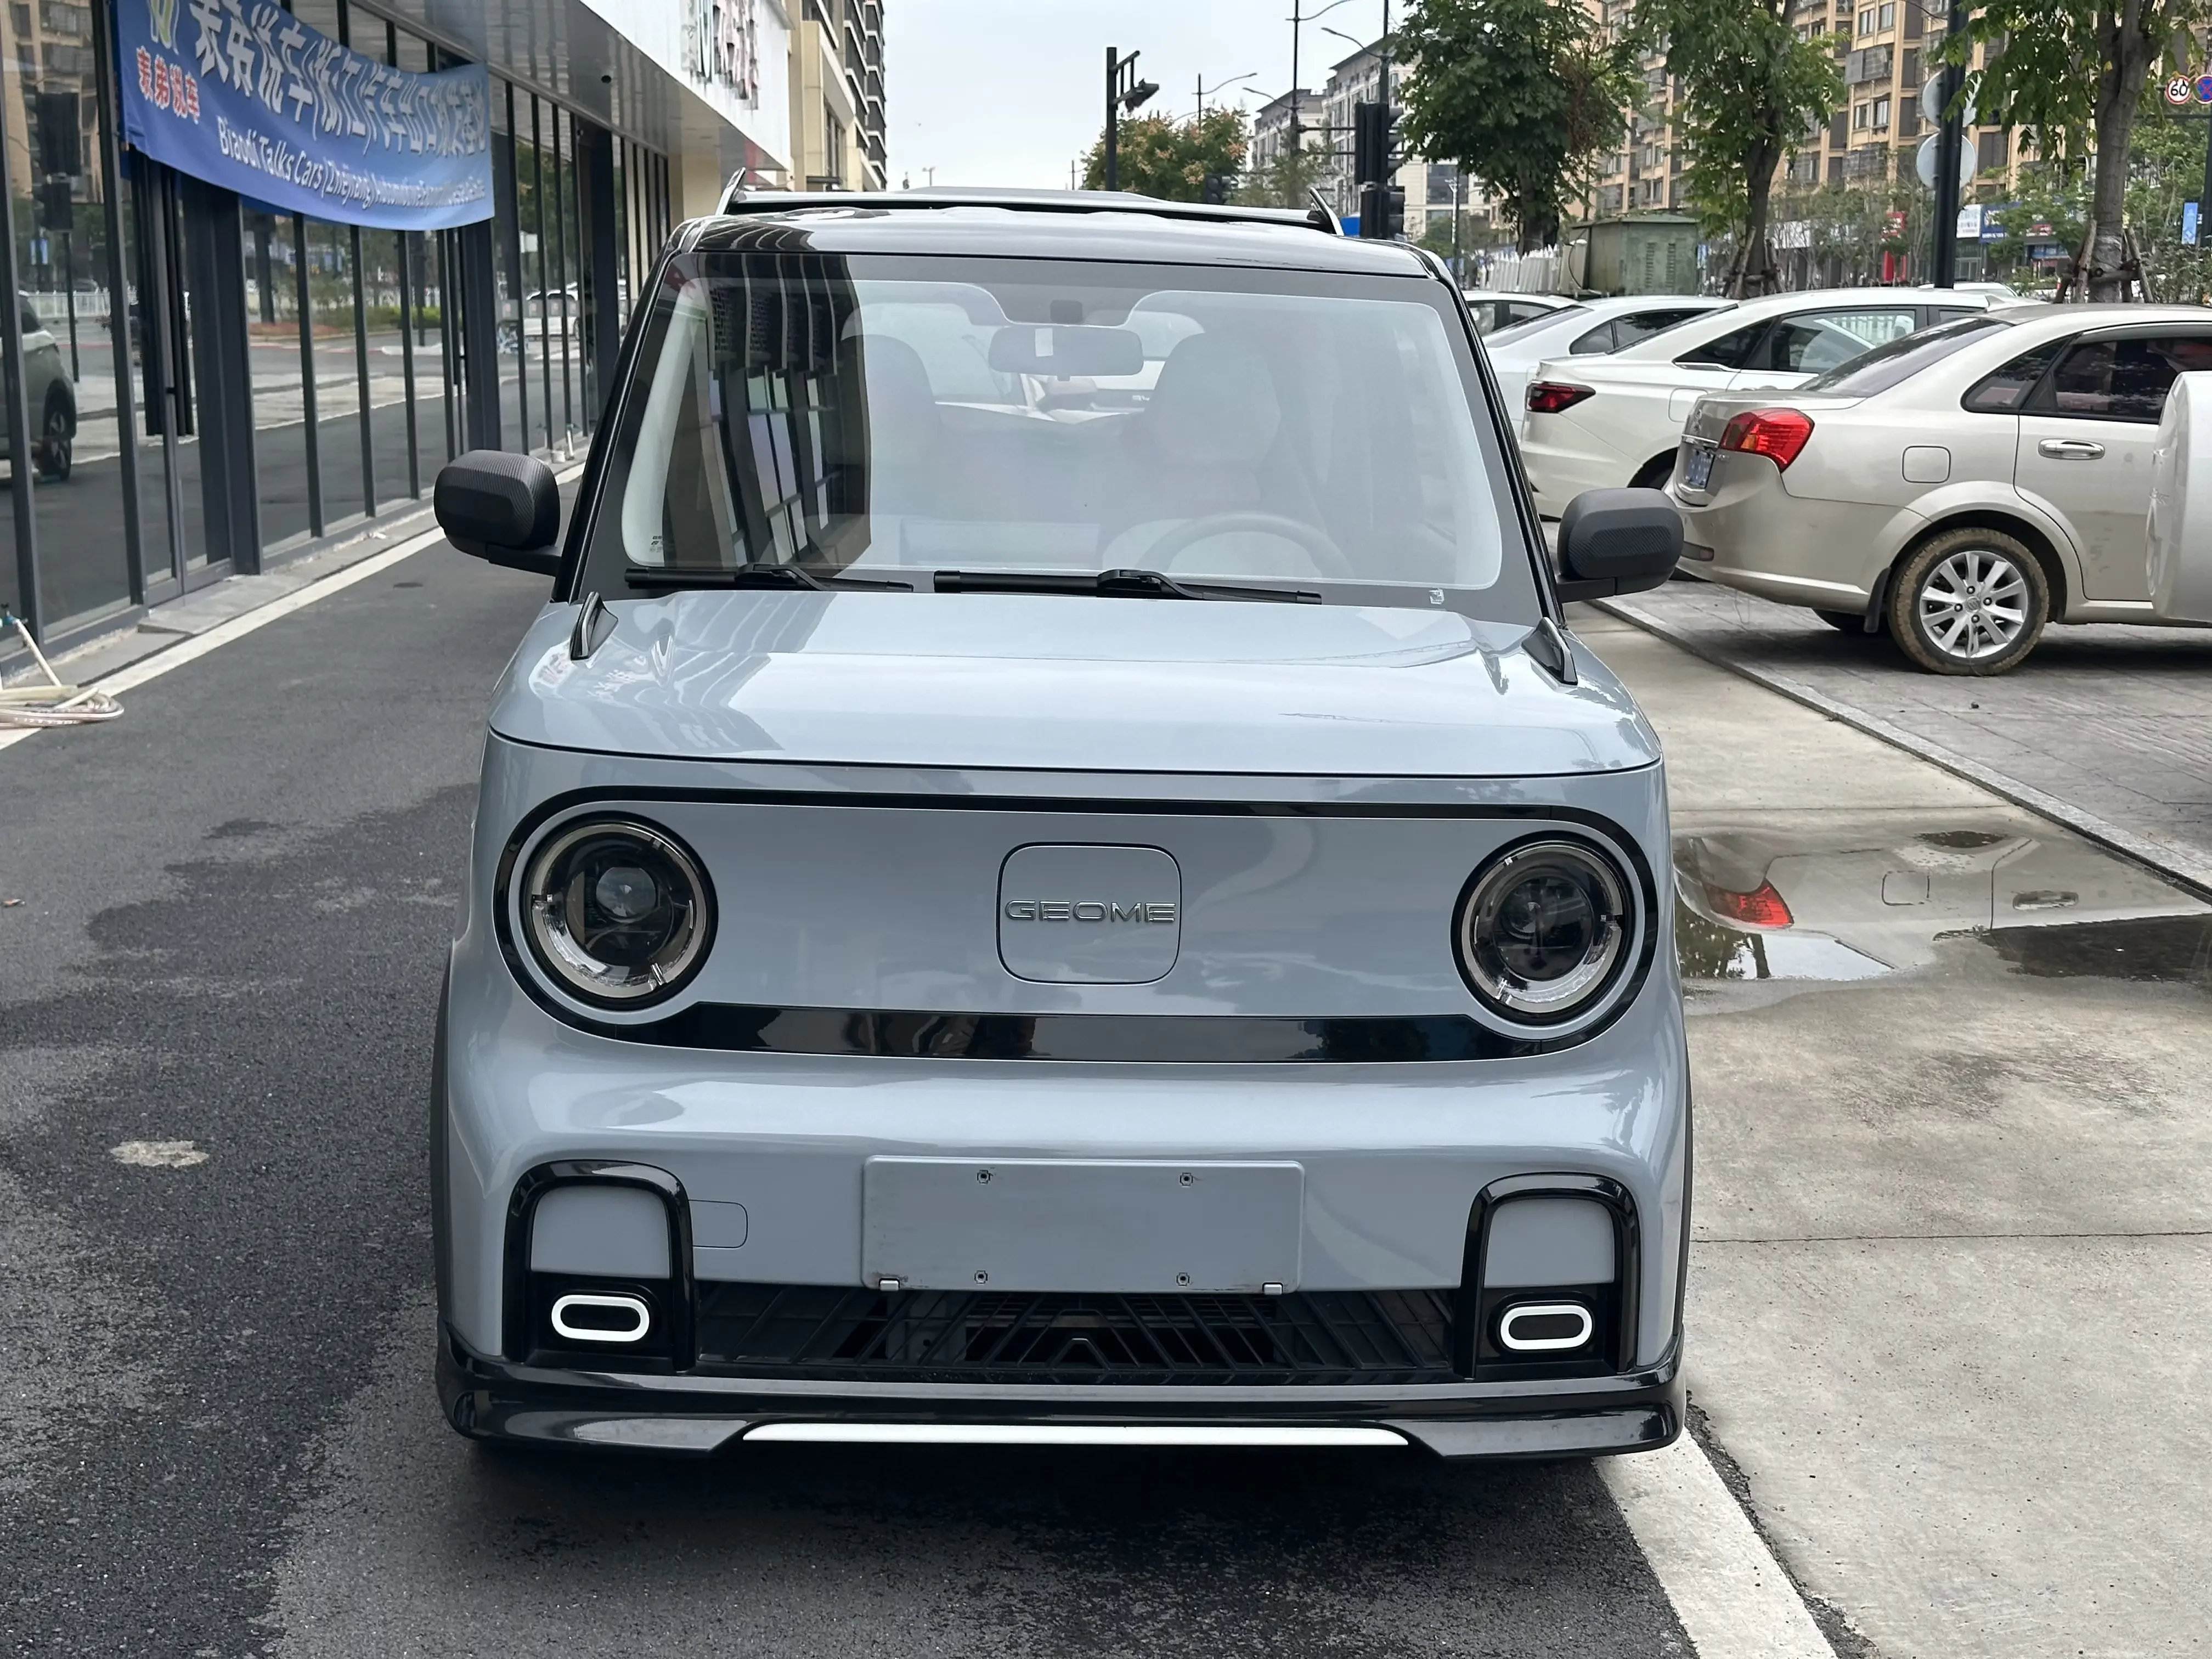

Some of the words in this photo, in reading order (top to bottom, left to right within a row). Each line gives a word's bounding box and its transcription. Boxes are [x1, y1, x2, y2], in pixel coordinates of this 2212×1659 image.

[2171, 80, 2187, 96] 60
[259, 136, 295, 182] Talks
[294, 150, 324, 190] Cars
[1005, 900, 1176, 923] GEOME
